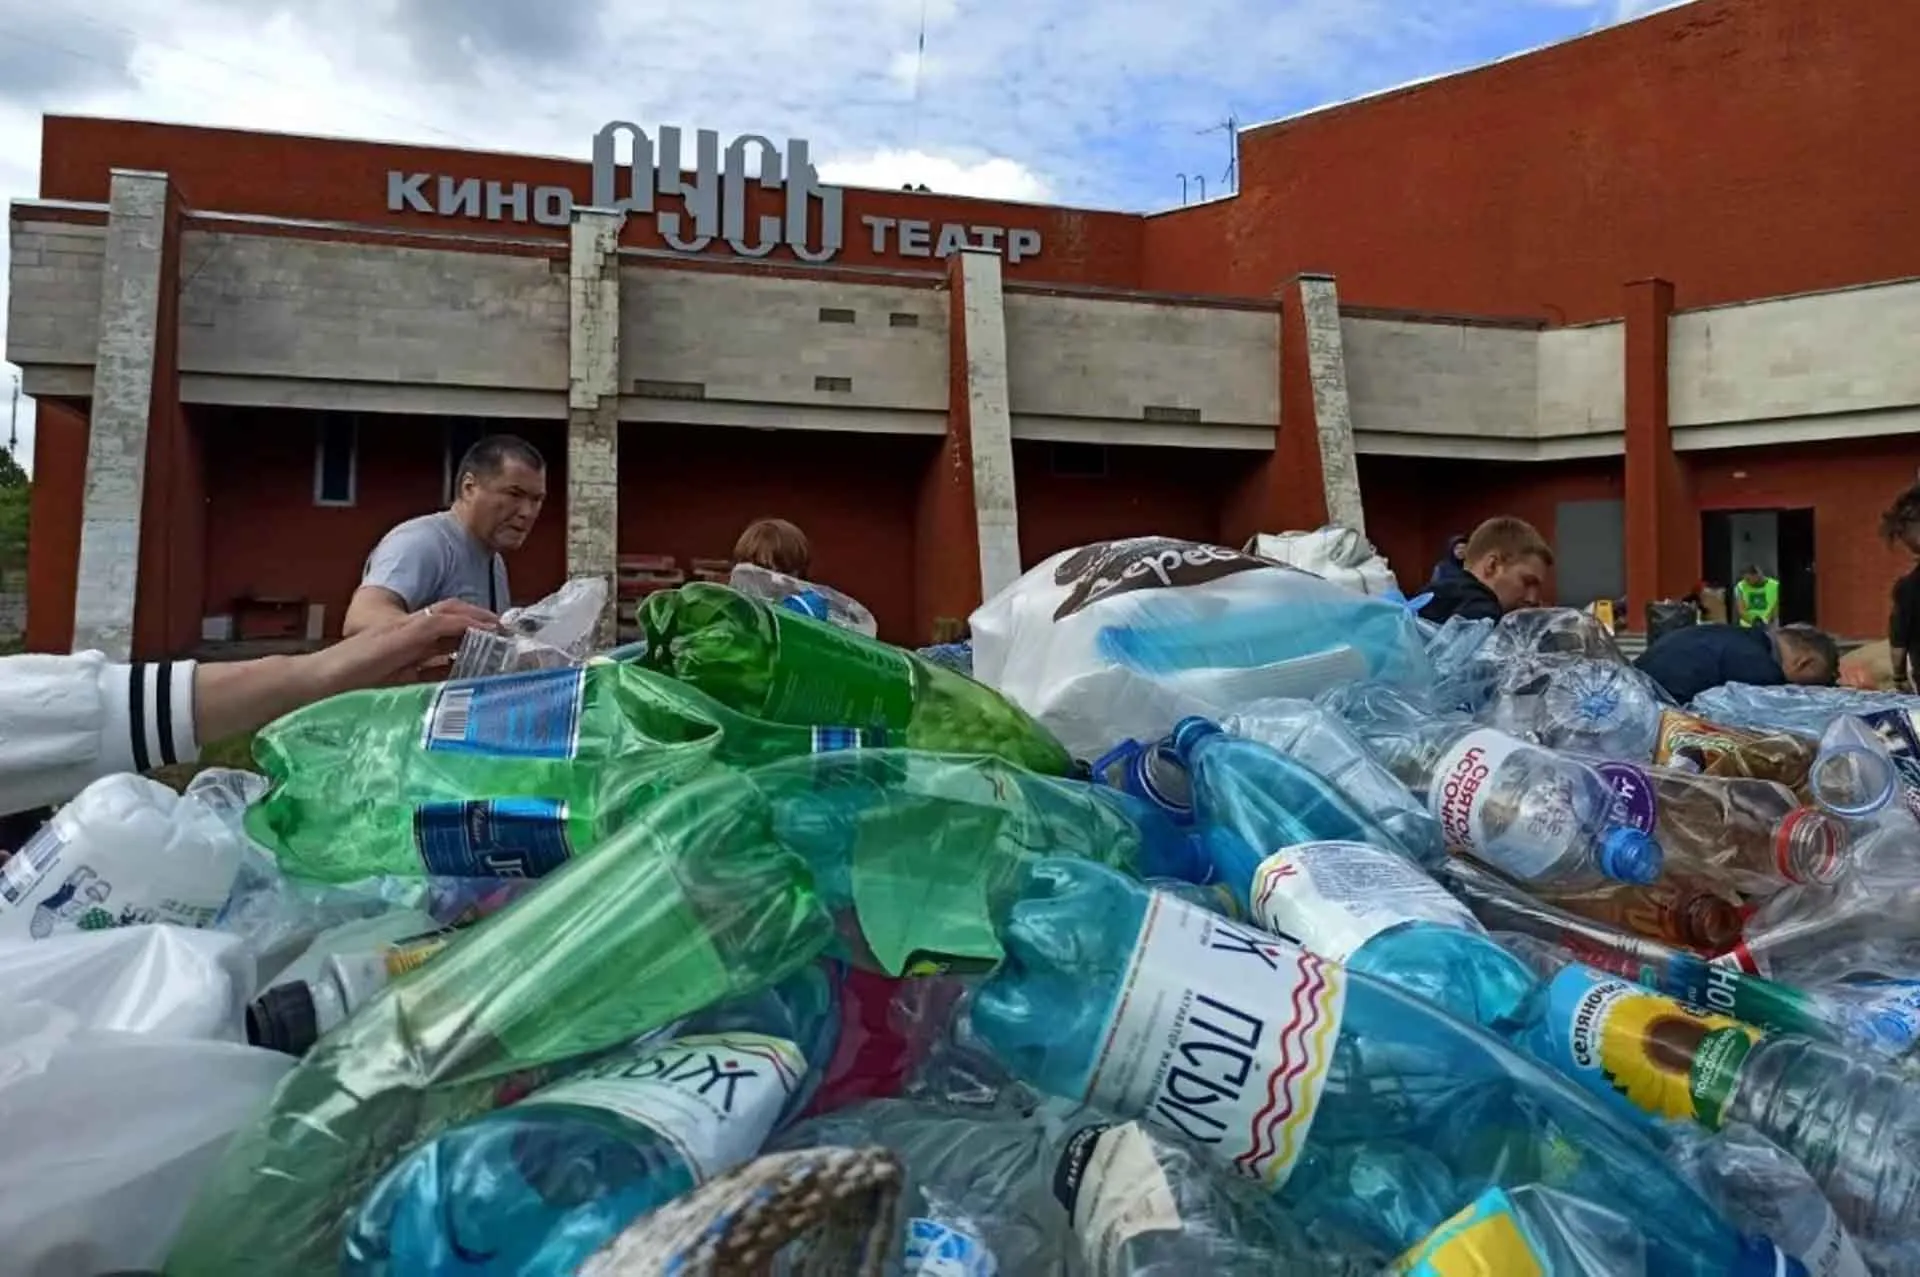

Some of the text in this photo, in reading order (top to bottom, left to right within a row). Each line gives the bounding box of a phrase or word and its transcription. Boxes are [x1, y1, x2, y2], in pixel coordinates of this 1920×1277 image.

[387, 120, 1041, 264] КИНО РУСЬ ТЕАТР
